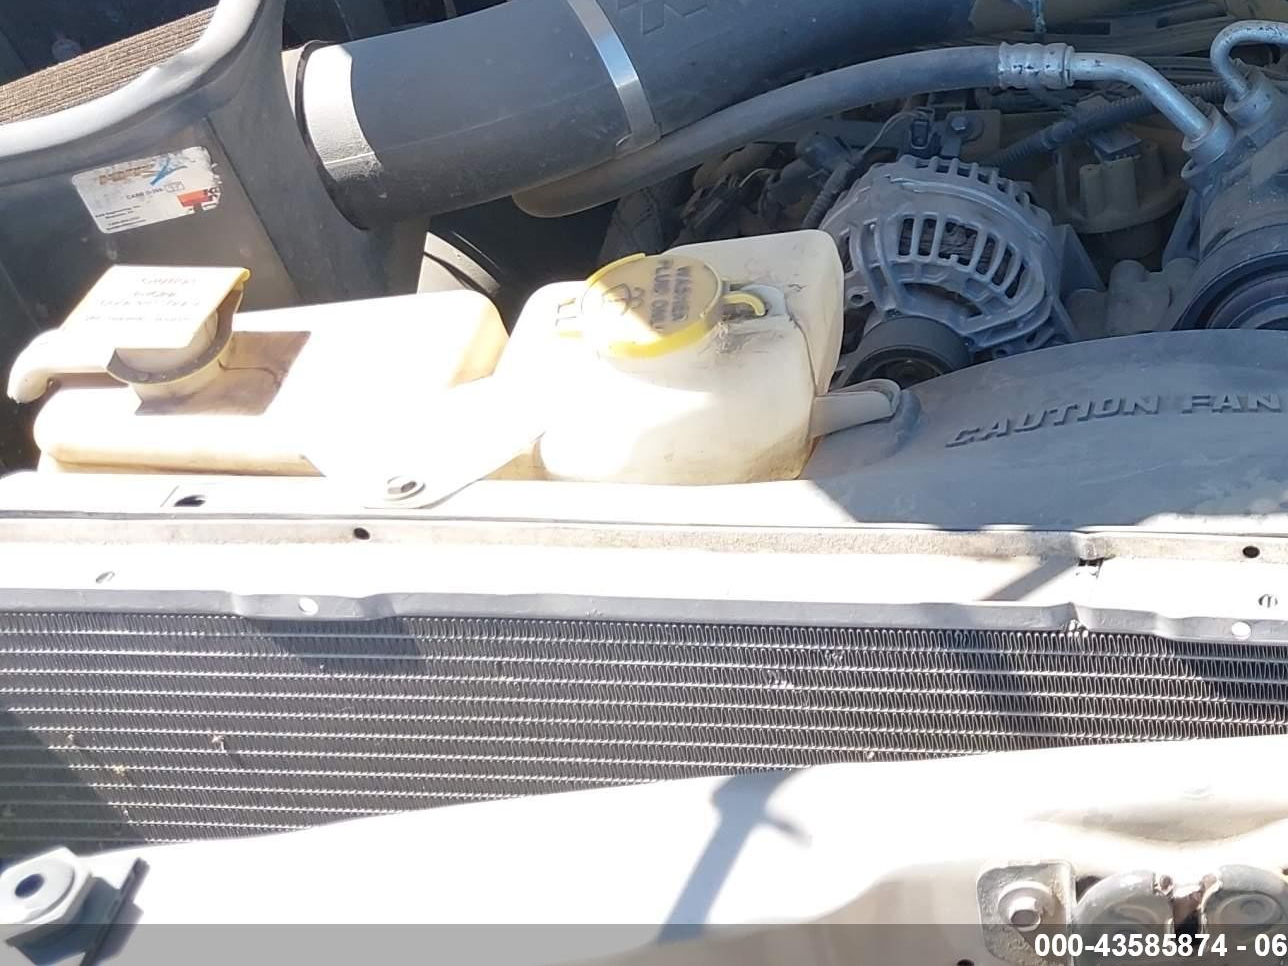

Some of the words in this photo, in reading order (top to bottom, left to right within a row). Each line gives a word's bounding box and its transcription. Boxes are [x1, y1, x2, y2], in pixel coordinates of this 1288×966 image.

[673, 265, 693, 322] WASHER
[945, 394, 1161, 448] CAUTION
[1182, 392, 1282, 415] FAN
